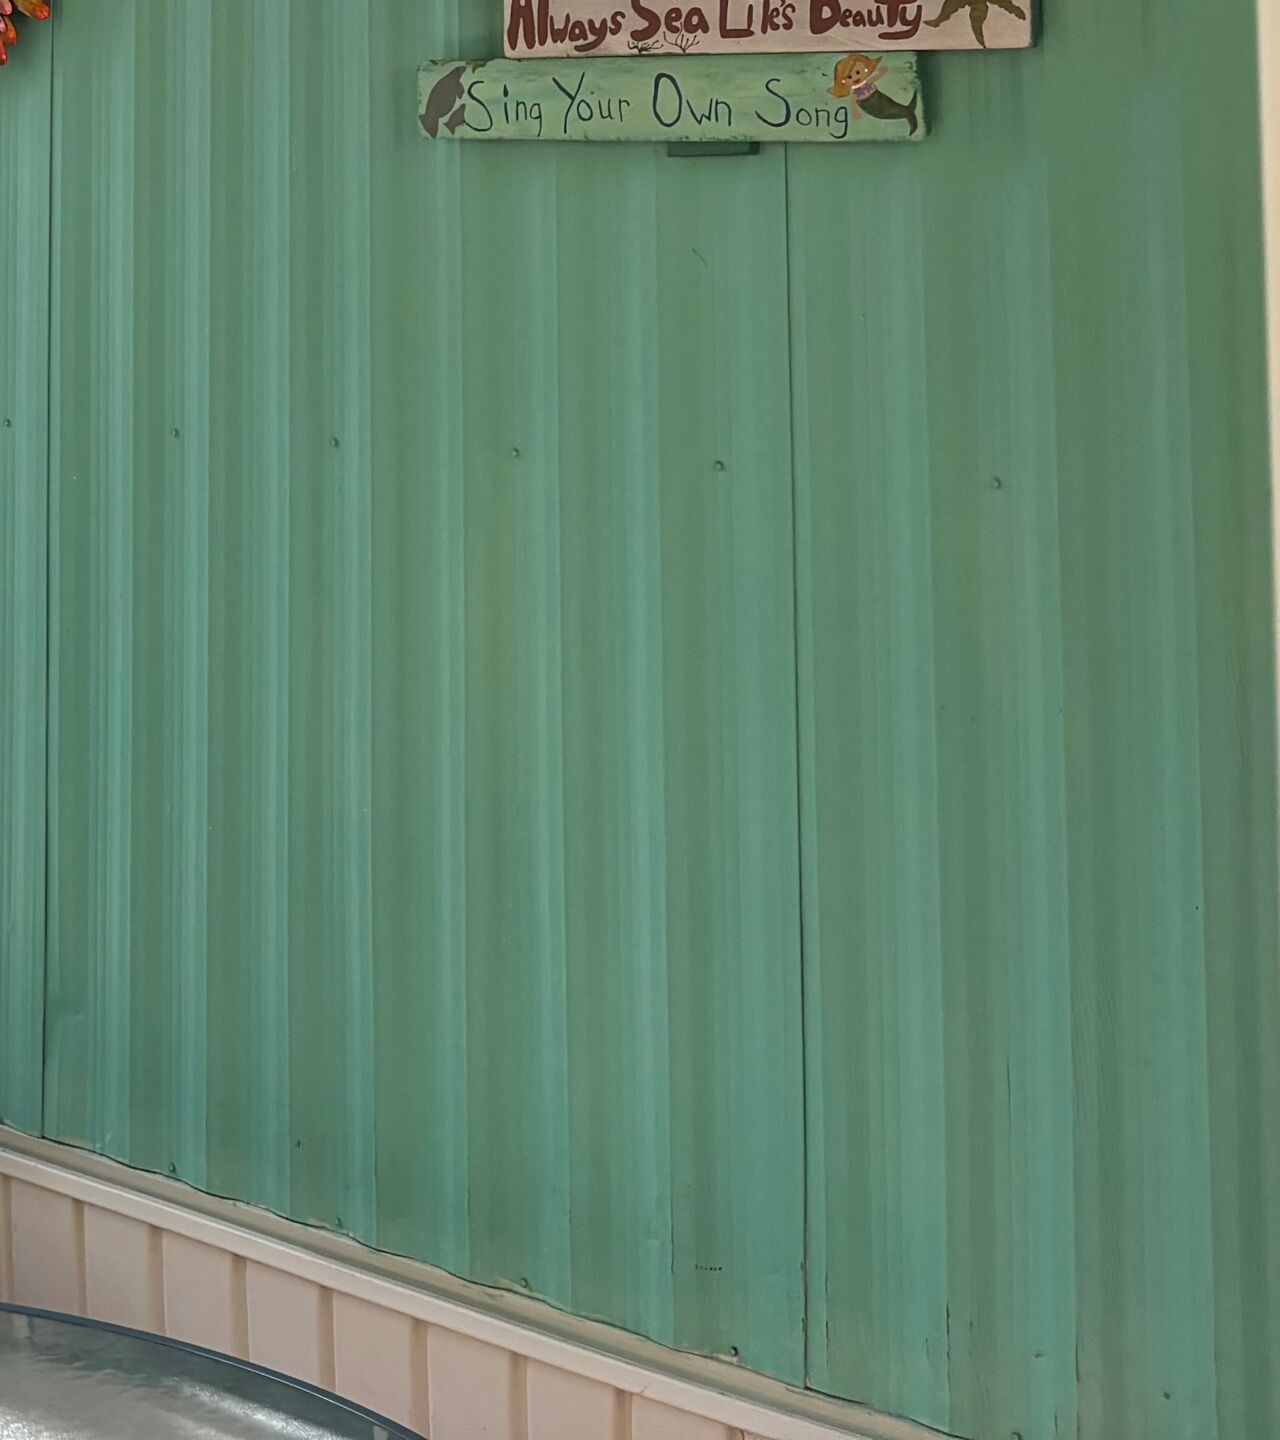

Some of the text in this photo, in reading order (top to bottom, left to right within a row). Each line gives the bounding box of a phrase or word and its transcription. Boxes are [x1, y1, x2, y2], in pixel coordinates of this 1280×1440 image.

[463, 72, 849, 138] Sing Your Own Song
